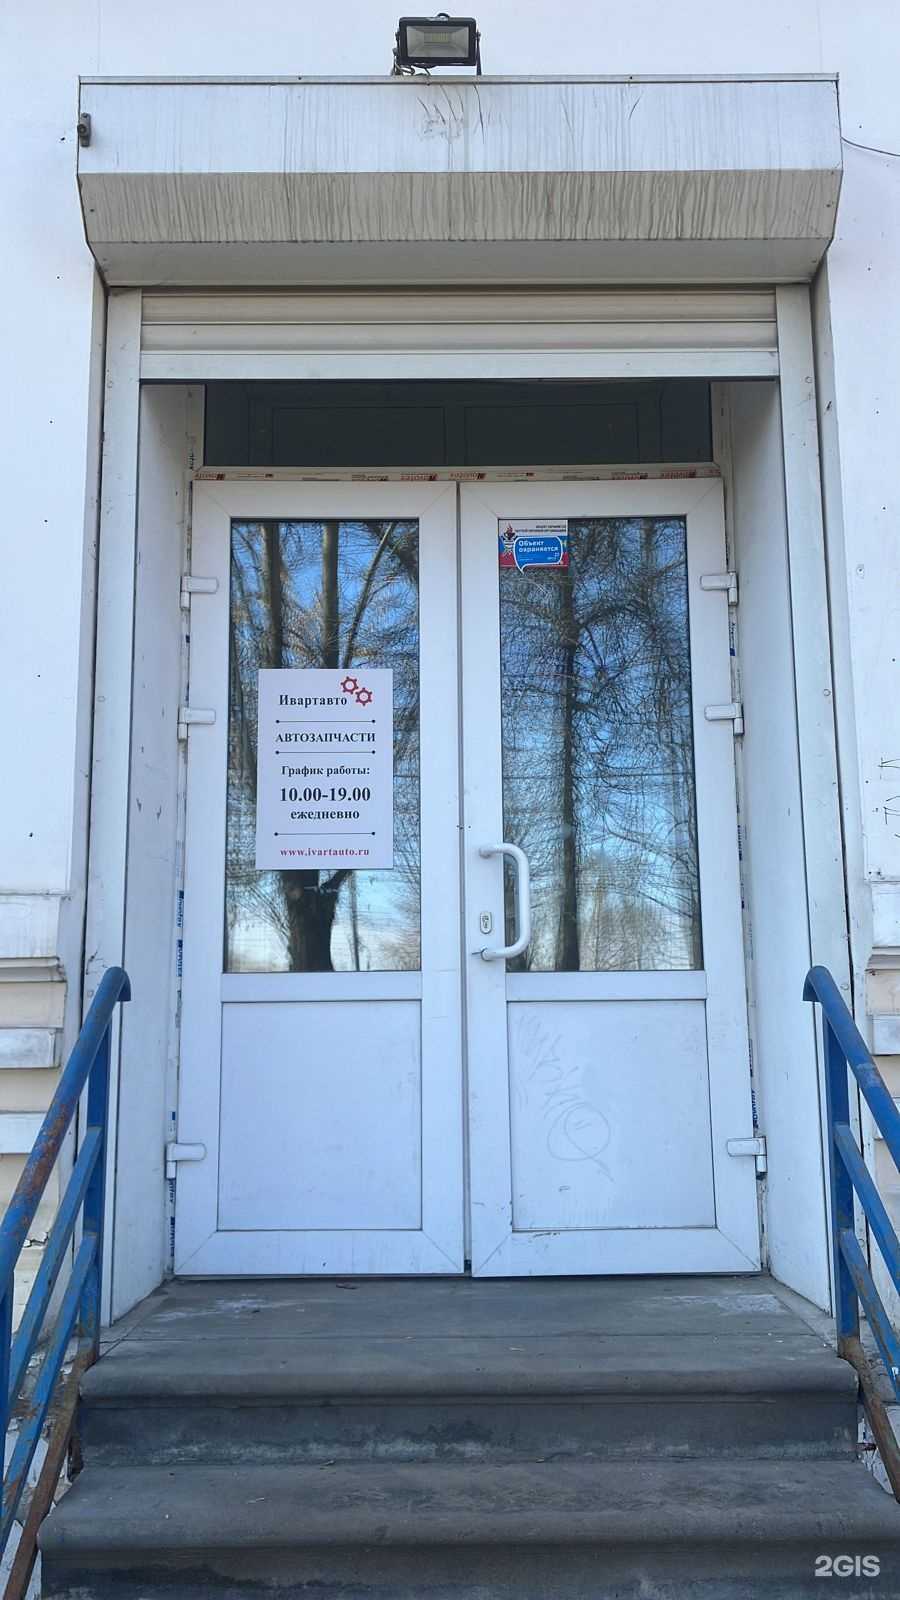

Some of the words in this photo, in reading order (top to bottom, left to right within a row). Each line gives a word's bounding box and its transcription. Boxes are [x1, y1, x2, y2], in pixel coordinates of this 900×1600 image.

[279, 694, 347, 708] Ивартавто
[275, 732, 376, 743] АВТОЗАПЧАСТИ
[281, 765, 324, 777] График
[326, 765, 370, 777] работы:
[280, 787, 371, 802] 10.00-19.00
[290, 809, 360, 821] ежедневно
[280, 847, 370, 856] www.ivartauto.ru
